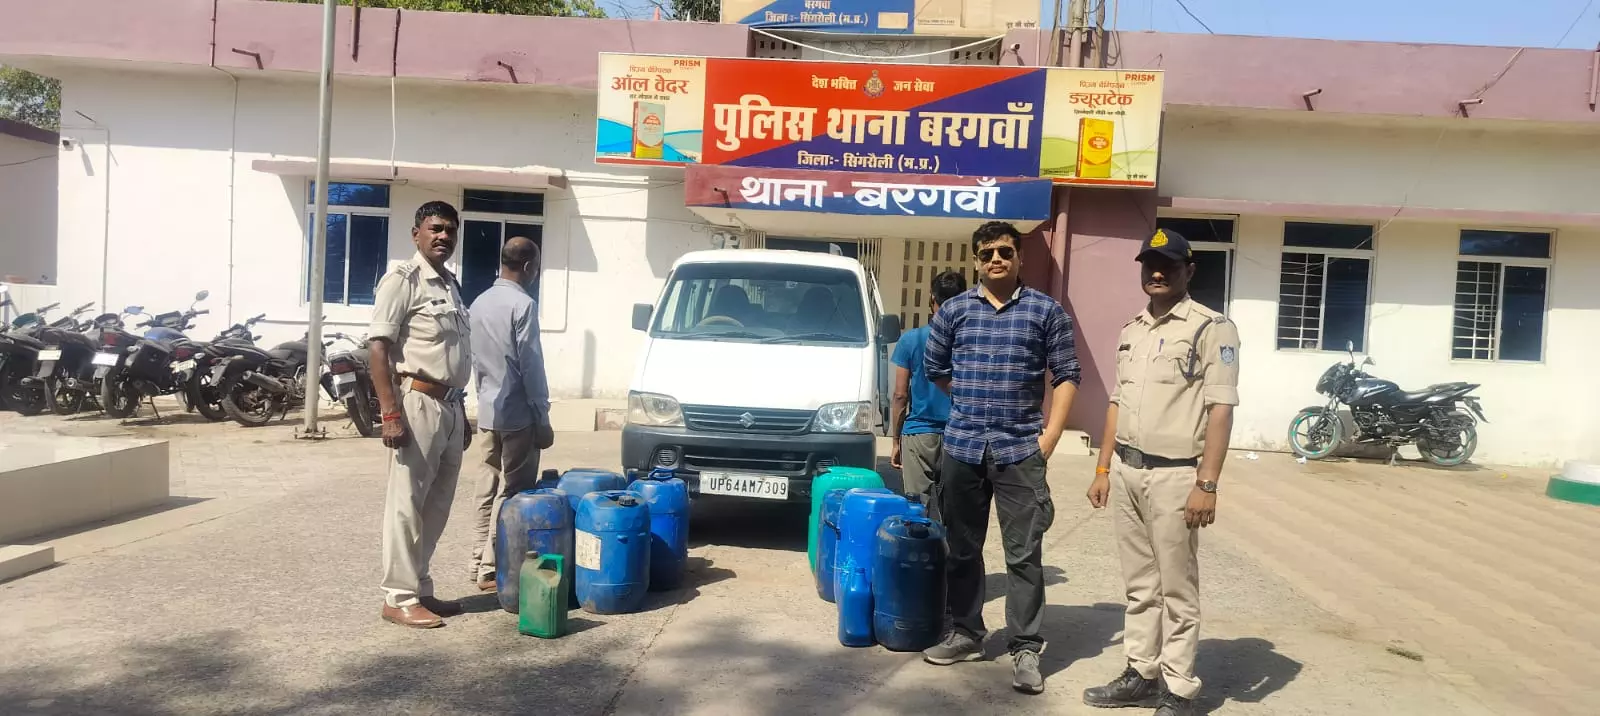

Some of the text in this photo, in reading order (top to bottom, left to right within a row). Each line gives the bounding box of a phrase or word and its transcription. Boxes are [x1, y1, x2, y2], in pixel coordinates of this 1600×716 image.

[673, 59, 701, 68] PRISM
[611, 74, 690, 95] ऑल वेदर
[811, 76, 829, 90] देश
[893, 80, 912, 93] जन
[914, 79, 936, 93] सेवा
[1124, 73, 1156, 82] PRISM
[1069, 89, 1135, 109] ड्यूराटेक
[713, 94, 818, 152] पुलिस
[826, 107, 911, 146] थाना
[918, 101, 1035, 149] बरगवाँ
[843, 152, 894, 170] सिंगरौली
[897, 154, 941, 174] (म.प्र.)
[739, 176, 828, 208] थाना
[852, 176, 1001, 215] बरगवाँ
[710, 477, 787, 495] UP64AM7309
